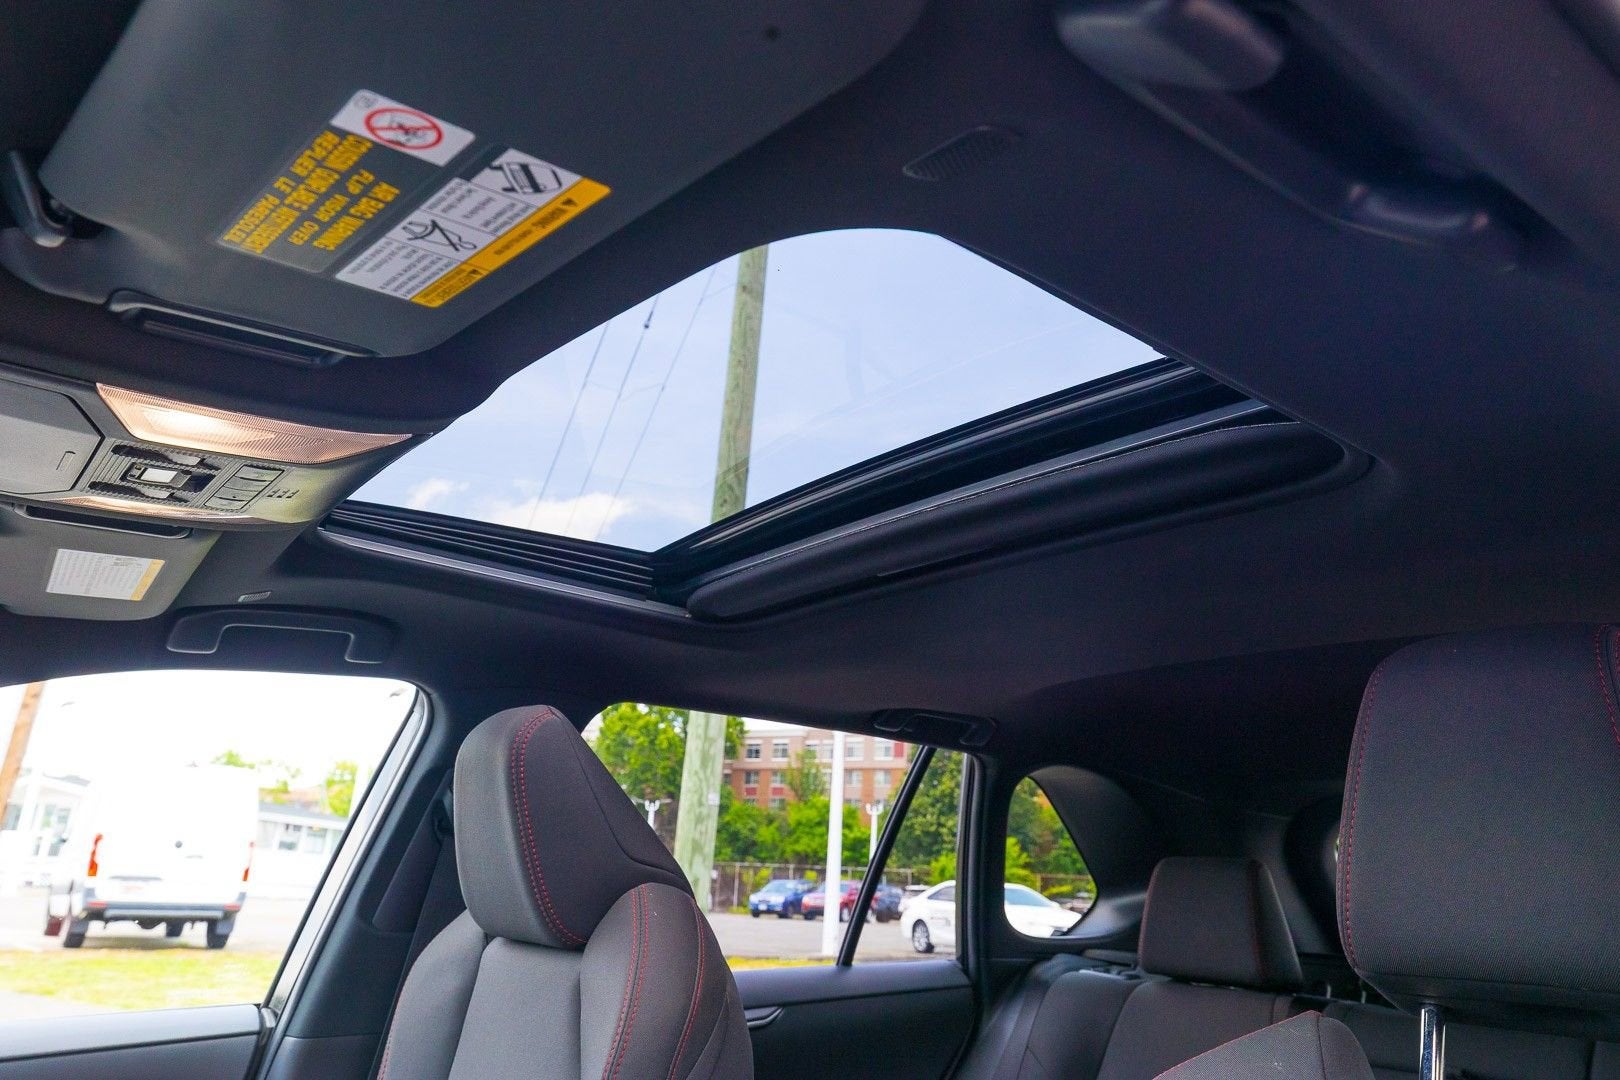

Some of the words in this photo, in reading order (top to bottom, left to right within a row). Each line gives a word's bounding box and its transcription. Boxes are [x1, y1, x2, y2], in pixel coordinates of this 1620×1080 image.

[346, 169, 375, 195] FLIP
[368, 181, 400, 203] AIR
[313, 194, 350, 222] VISOR
[349, 196, 385, 220] BAG
[287, 220, 320, 246] OVER
